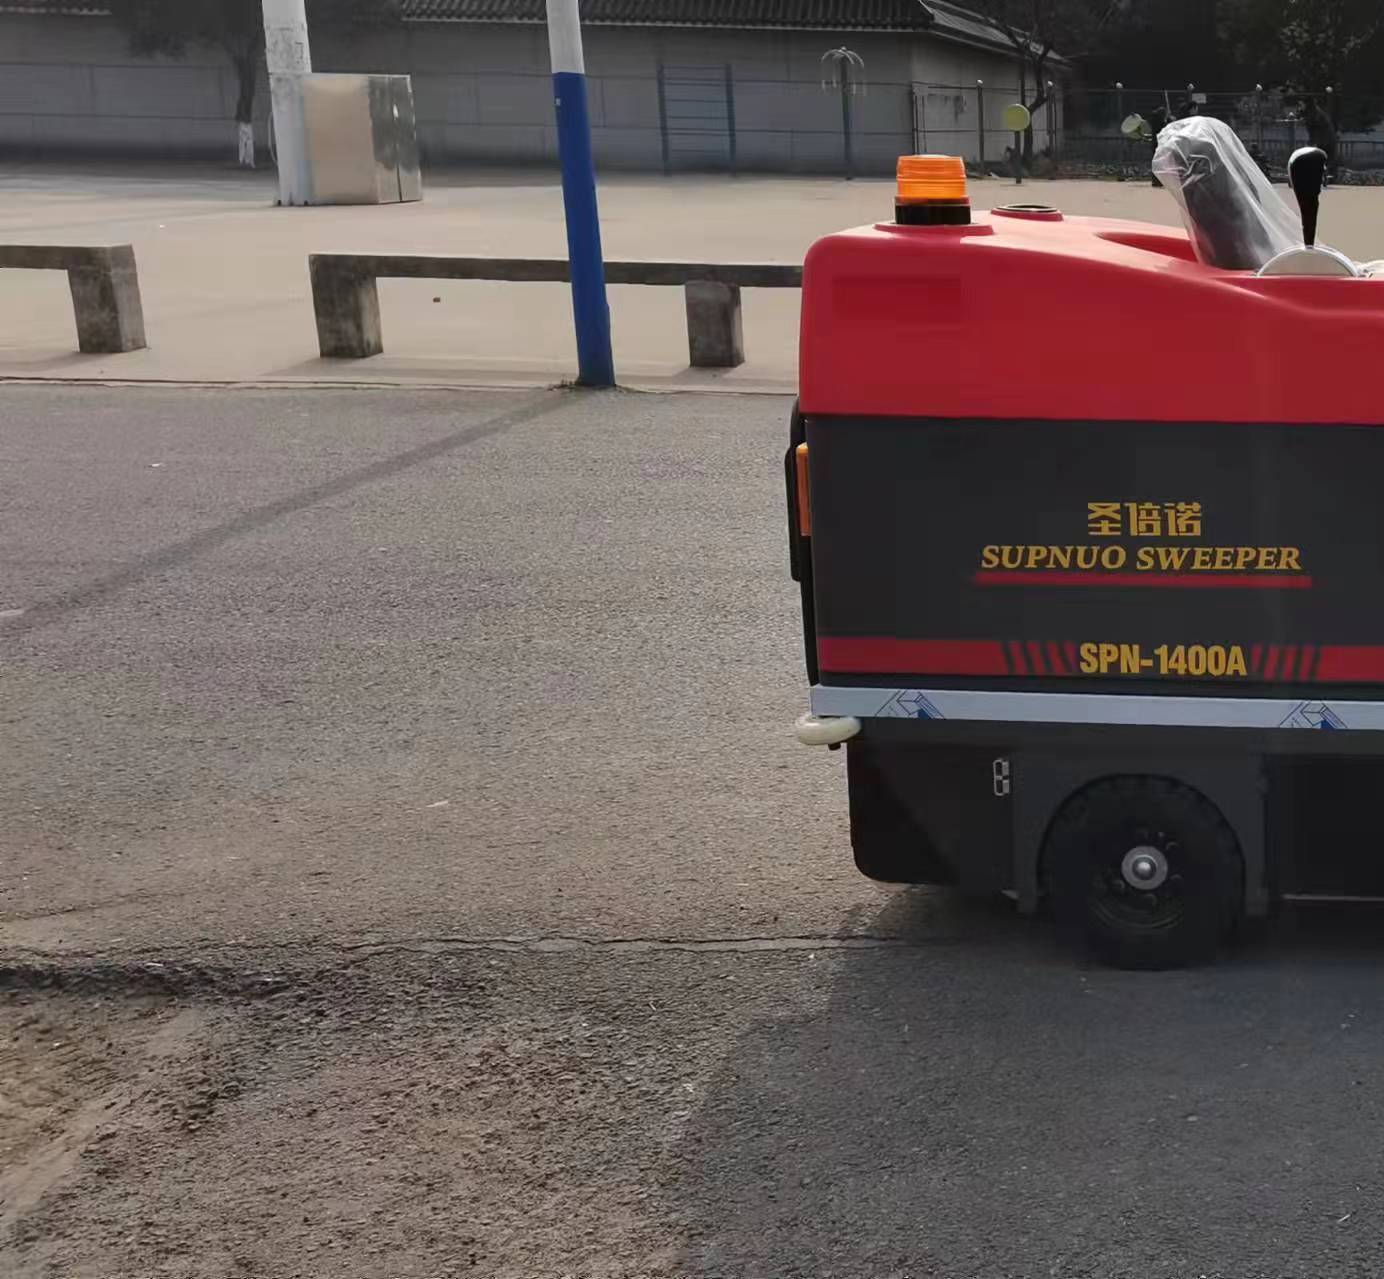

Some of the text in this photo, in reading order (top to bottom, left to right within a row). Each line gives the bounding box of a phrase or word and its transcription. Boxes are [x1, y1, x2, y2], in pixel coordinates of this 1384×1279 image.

[1088, 502, 1201, 536] 圣倍诺
[981, 545, 1301, 570] SUPNUO SWEEPER
[1079, 643, 1247, 676] SPN-1400A
